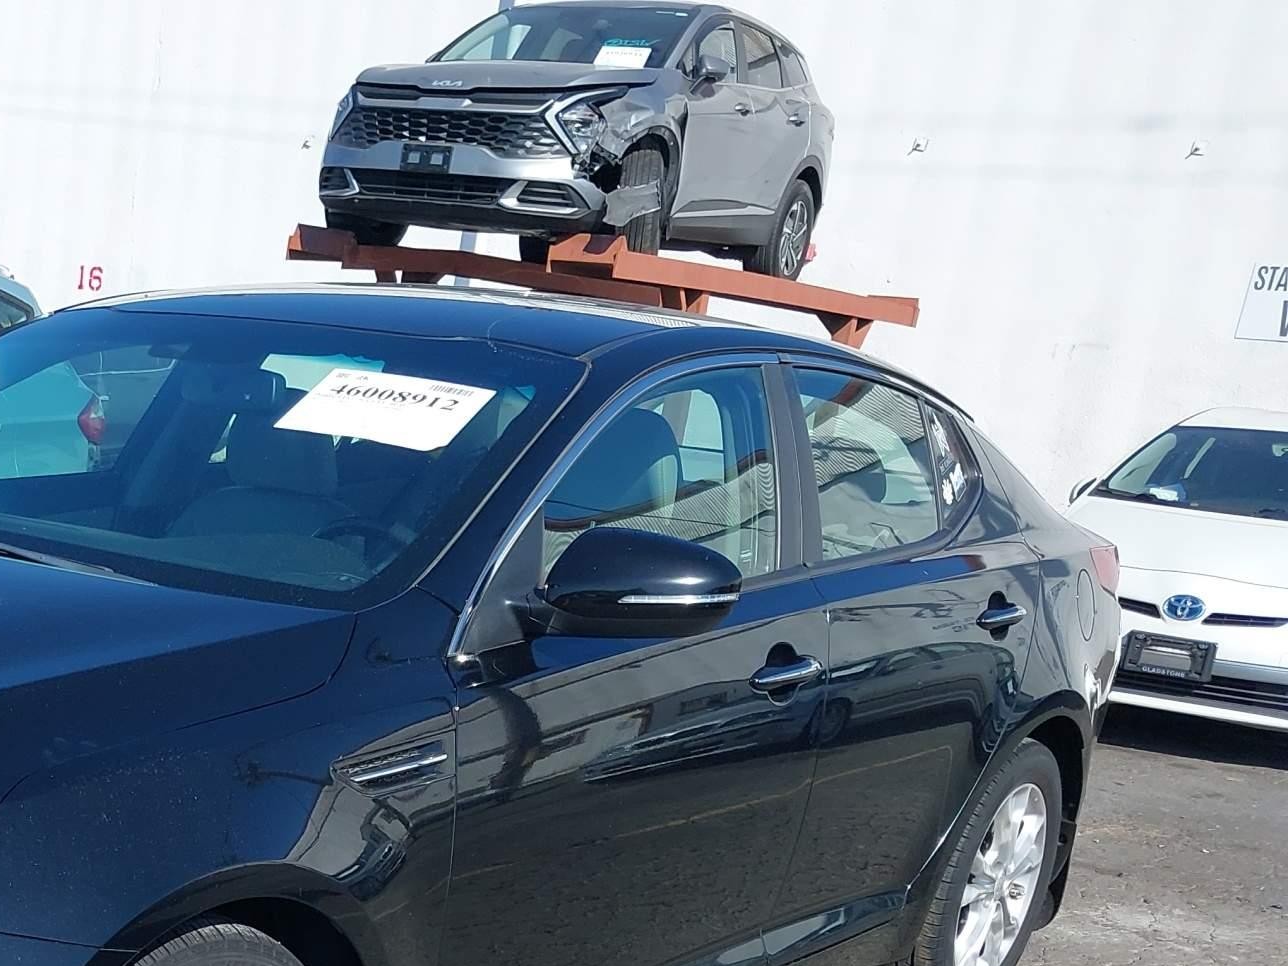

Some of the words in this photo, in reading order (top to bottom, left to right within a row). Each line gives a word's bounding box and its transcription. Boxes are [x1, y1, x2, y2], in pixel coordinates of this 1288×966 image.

[78, 265, 103, 291] 16
[1253, 266, 1288, 291] STA
[329, 383, 460, 412] 46008912
[1142, 666, 1185, 678] GLADSTONE
